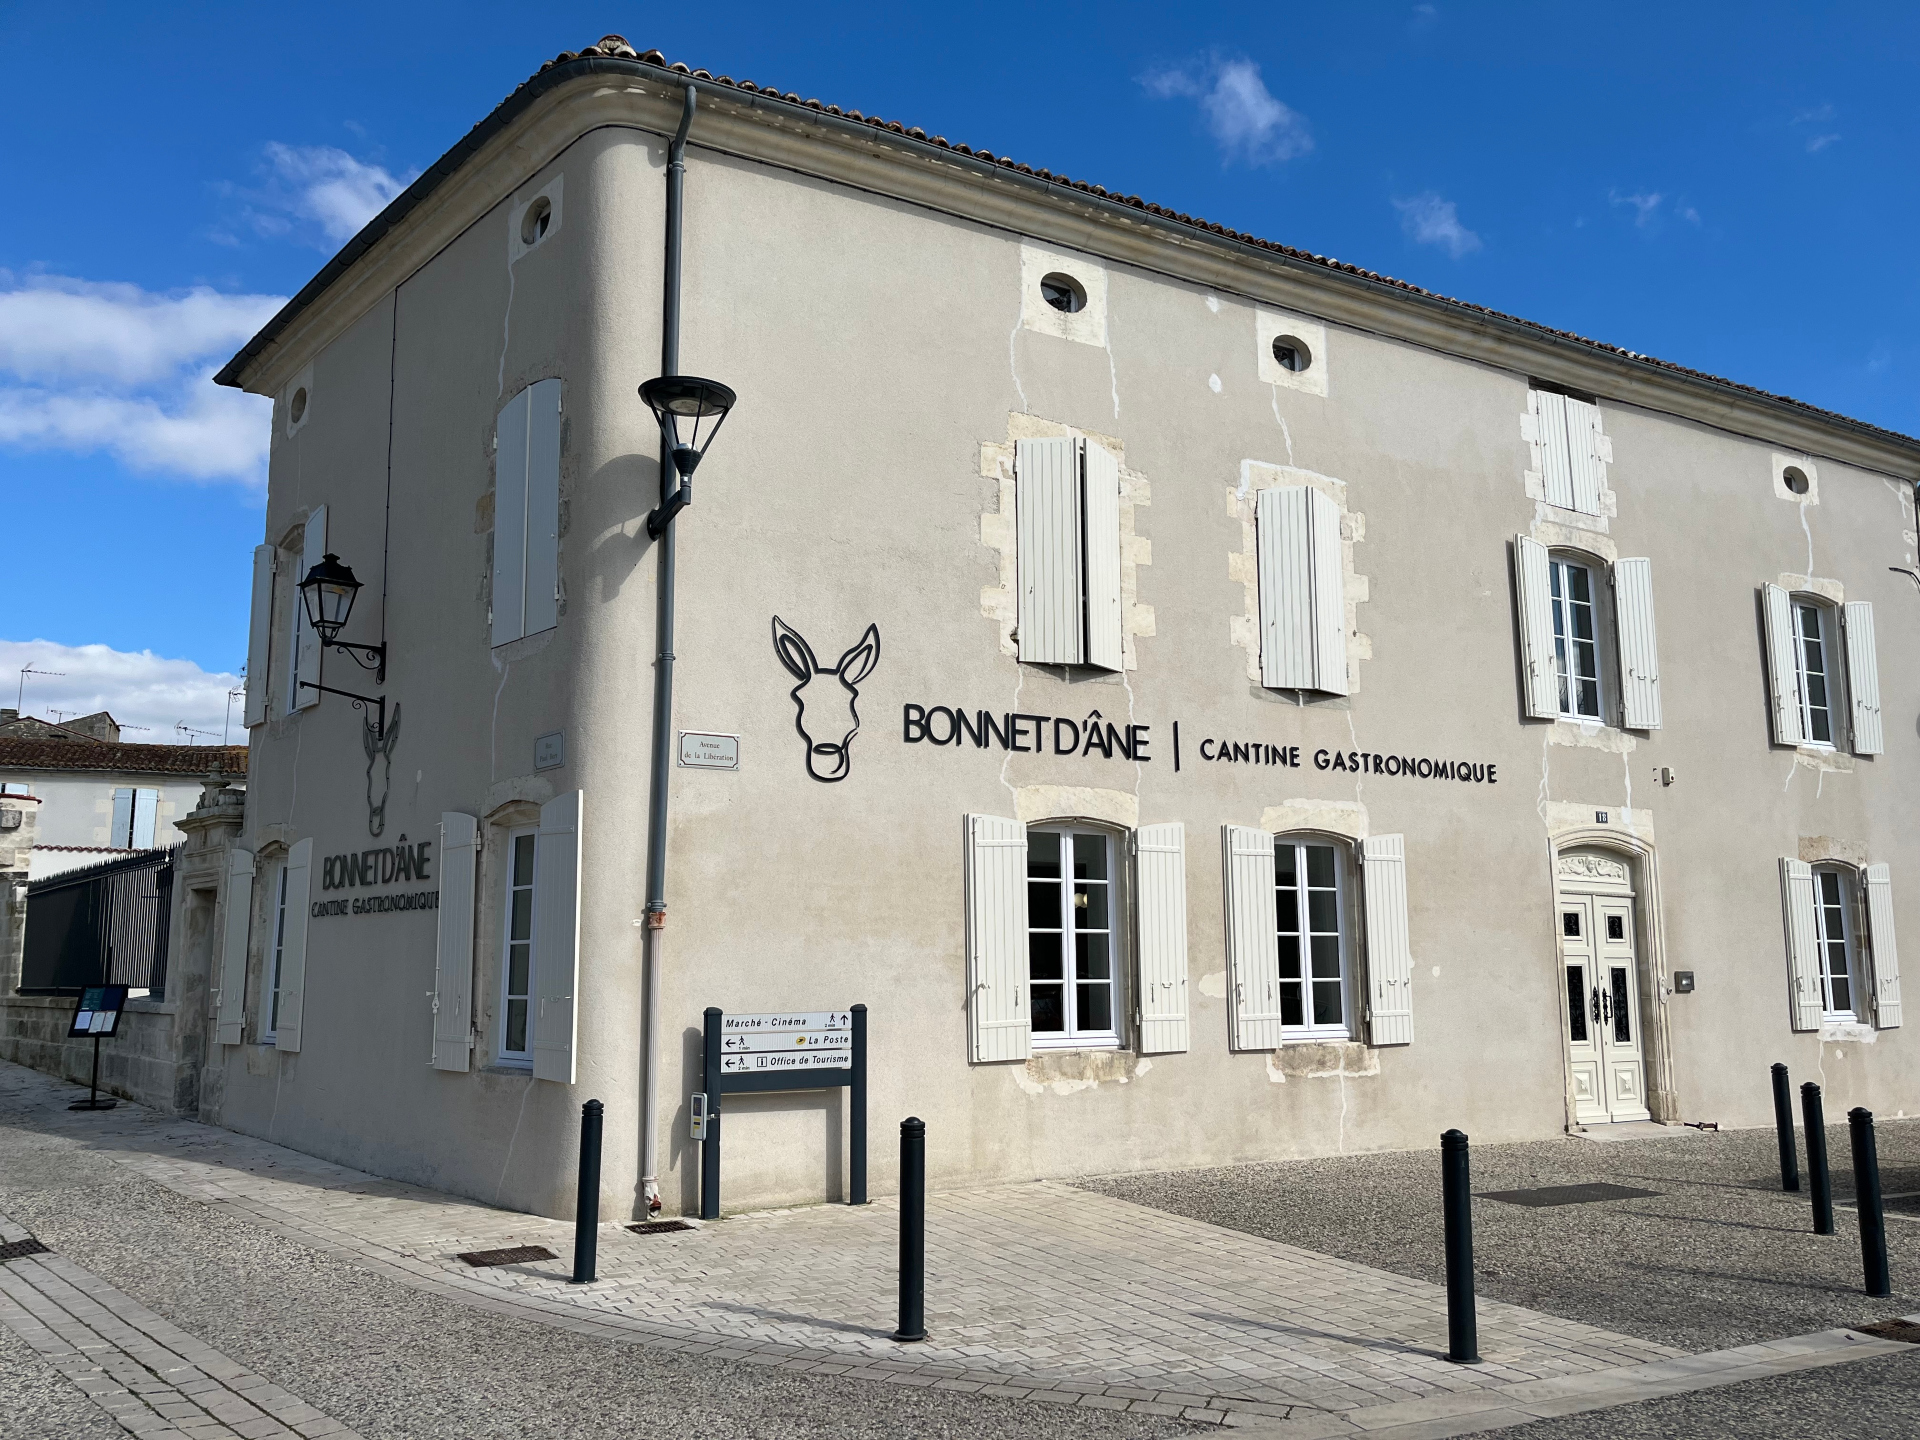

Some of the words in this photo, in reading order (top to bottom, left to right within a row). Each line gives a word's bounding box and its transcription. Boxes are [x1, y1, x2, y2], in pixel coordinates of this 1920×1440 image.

[699, 741, 720, 749] Avenue
[703, 753, 734, 761] Libération
[1200, 738, 1300, 768] CANTINE
[1313, 748, 1498, 784] GASTRONOMIQUE
[1598, 813, 1607, 822] 18
[311, 899, 349, 918] CANTINE
[352, 890, 440, 915] GASTRONOMIQUE
[725, 1018, 762, 1028] Marché
[771, 1017, 807, 1027] Cinéma
[808, 1036, 819, 1045] La
[823, 1035, 849, 1044] Poste
[770, 1056, 796, 1066] Office
[798, 1055, 809, 1065] de
[812, 1054, 849, 1064] Tourisme
